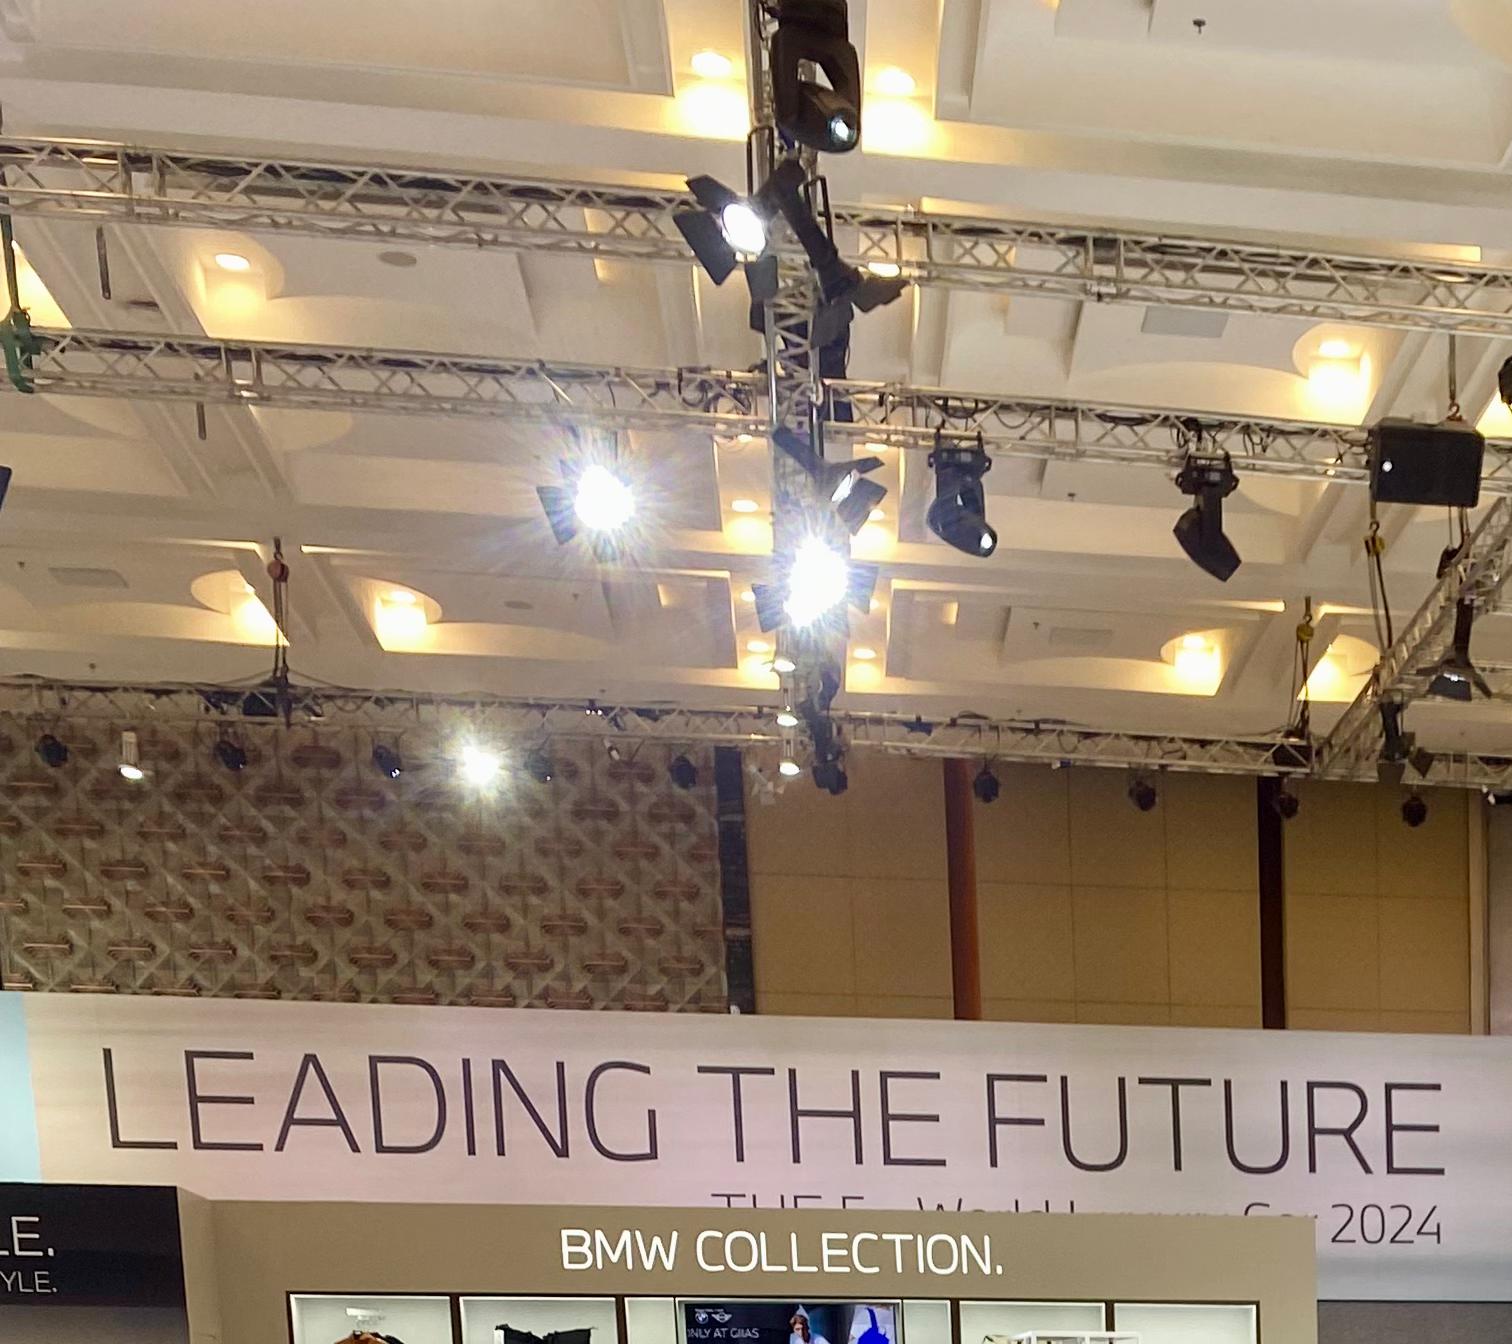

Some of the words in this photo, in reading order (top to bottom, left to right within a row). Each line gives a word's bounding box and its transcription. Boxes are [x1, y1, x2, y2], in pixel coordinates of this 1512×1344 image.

[102, 1047, 659, 1162] LEADING
[697, 1065, 947, 1168] THE
[985, 1073, 1446, 1177] FUTURE
[0, 1216, 55, 1256] E.
[1330, 1203, 1442, 1245] 2024
[560, 1228, 679, 1272] BMW
[695, 1229, 1003, 1275] COLLECTION.
[713, 1327, 729, 1339] AT
